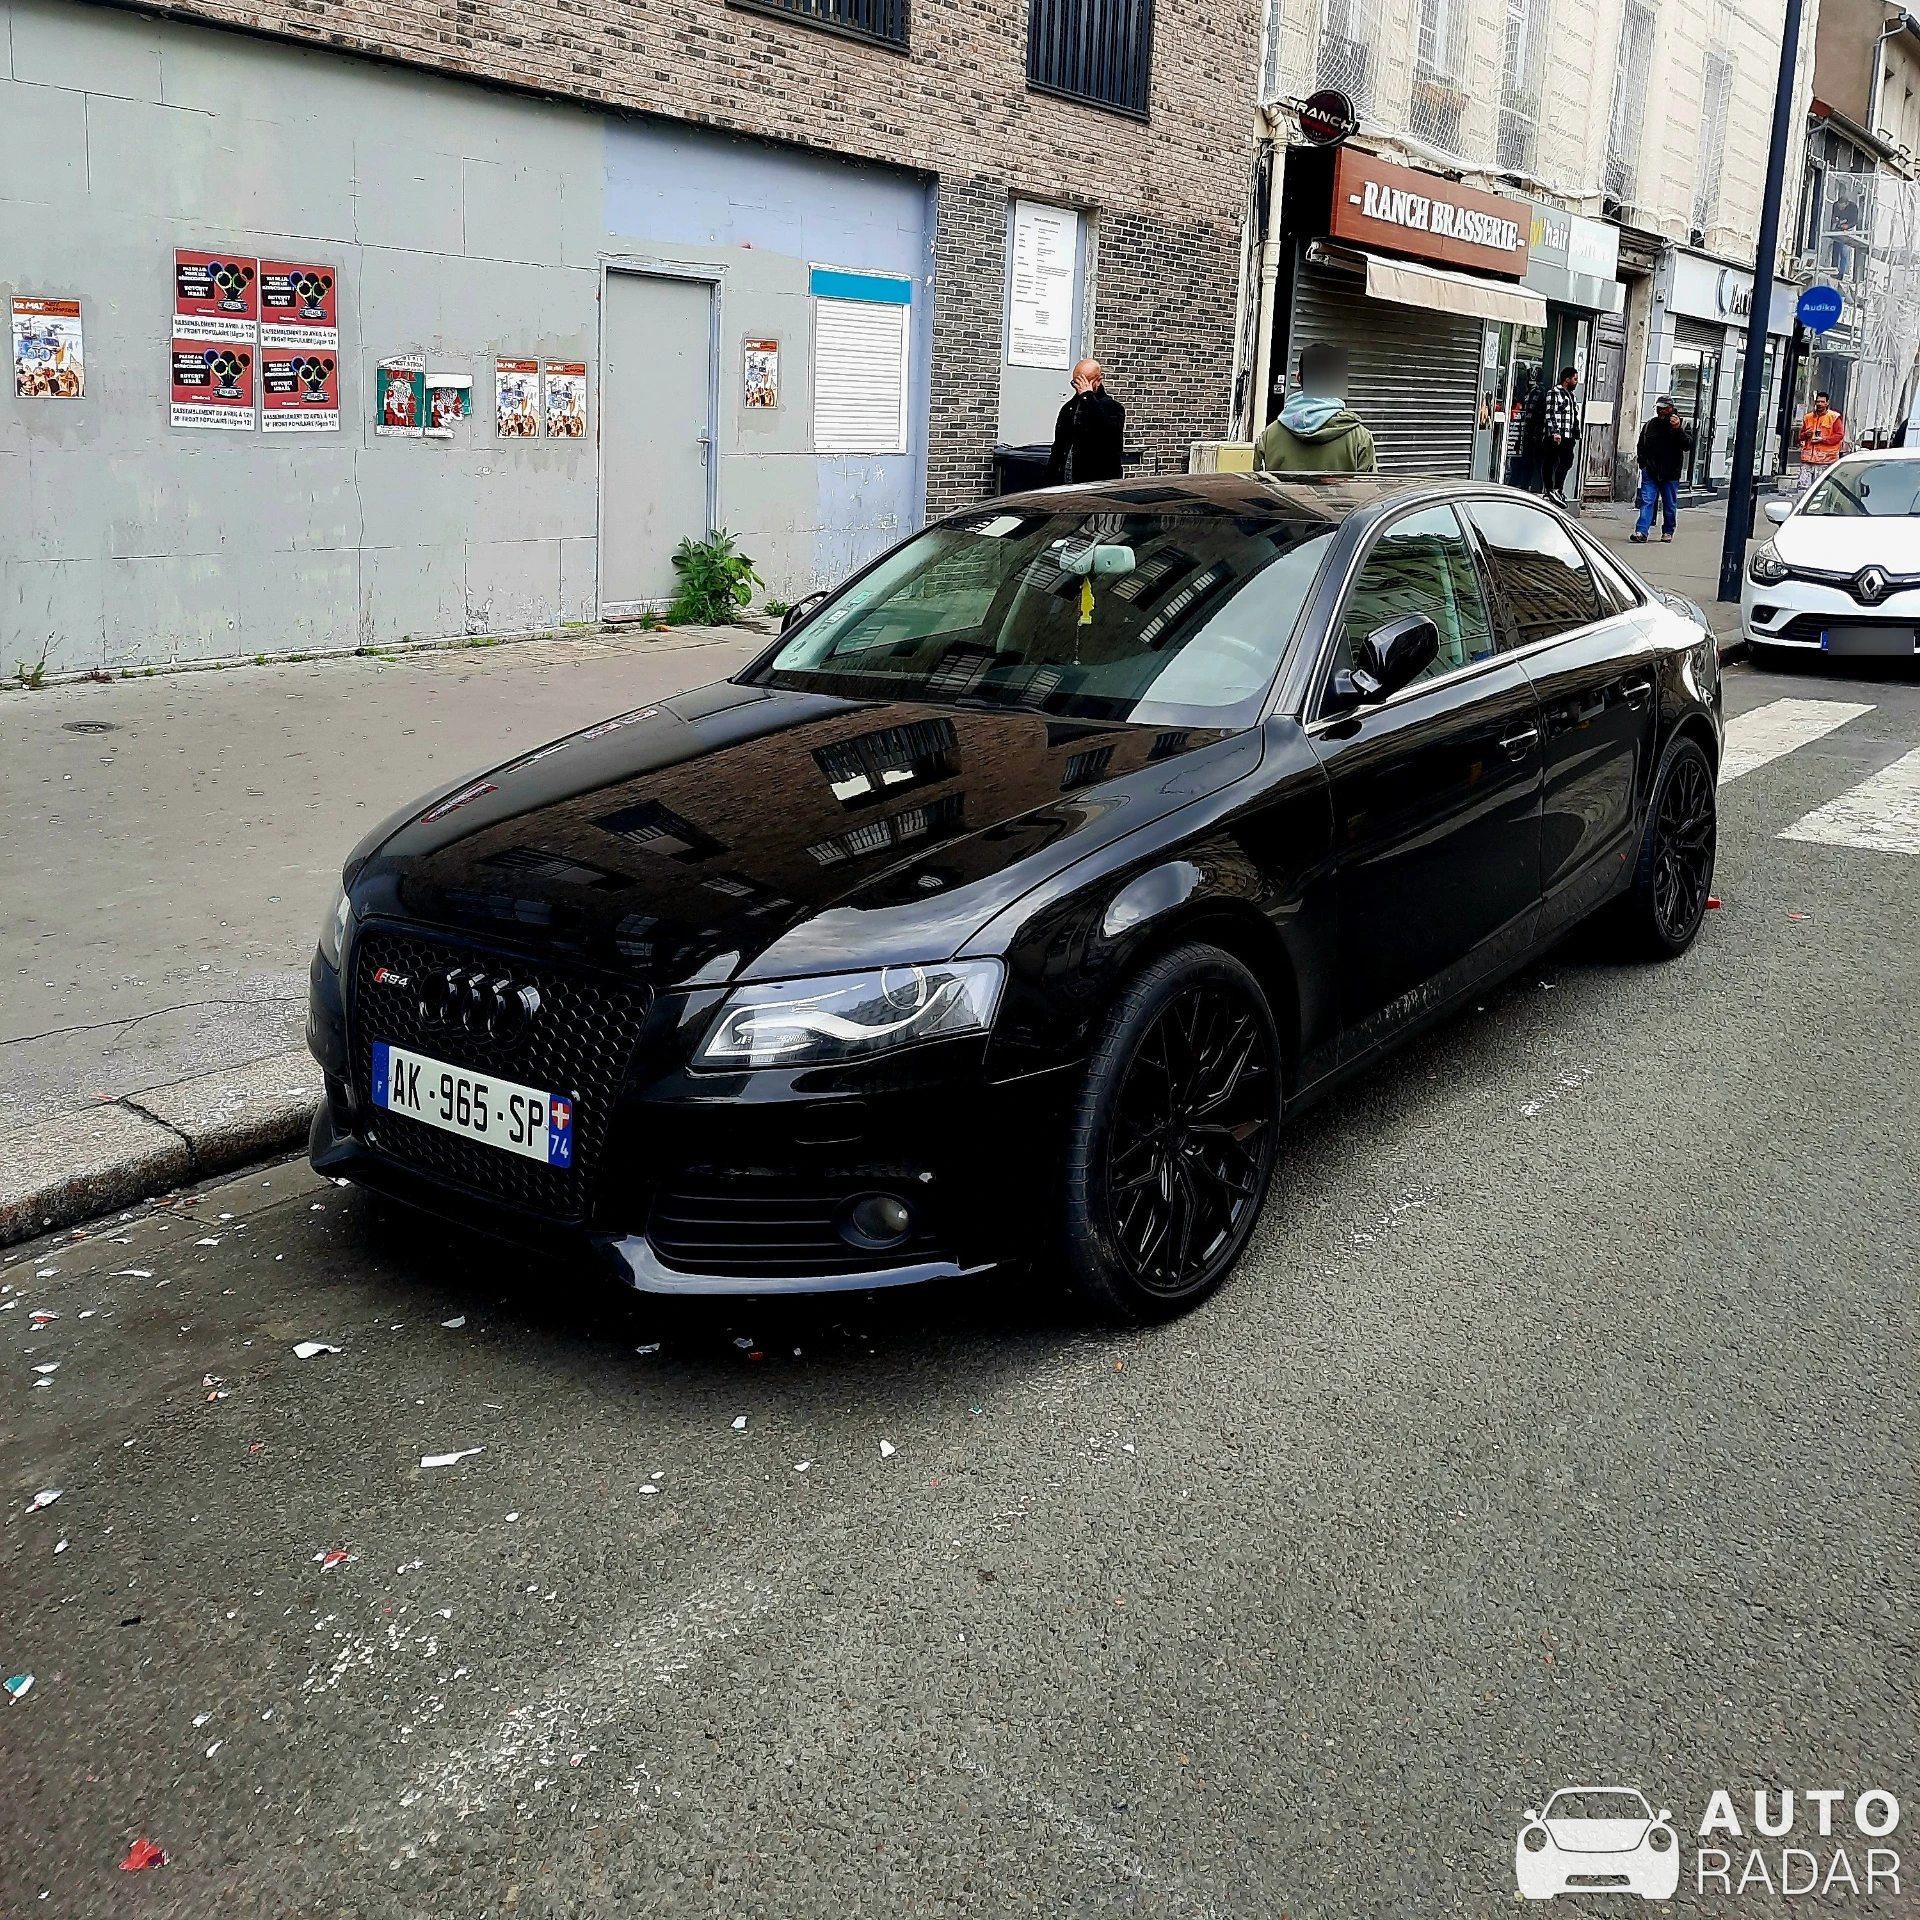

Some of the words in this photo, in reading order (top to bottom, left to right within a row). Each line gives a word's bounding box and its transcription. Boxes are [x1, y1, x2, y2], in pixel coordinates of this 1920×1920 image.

[1296, 101, 1353, 133] RANCH
[1803, 303, 1836, 312] Audika
[377, 970, 409, 987] RS4
[377, 1080, 382, 1093] F
[551, 1134, 569, 1159] 74
